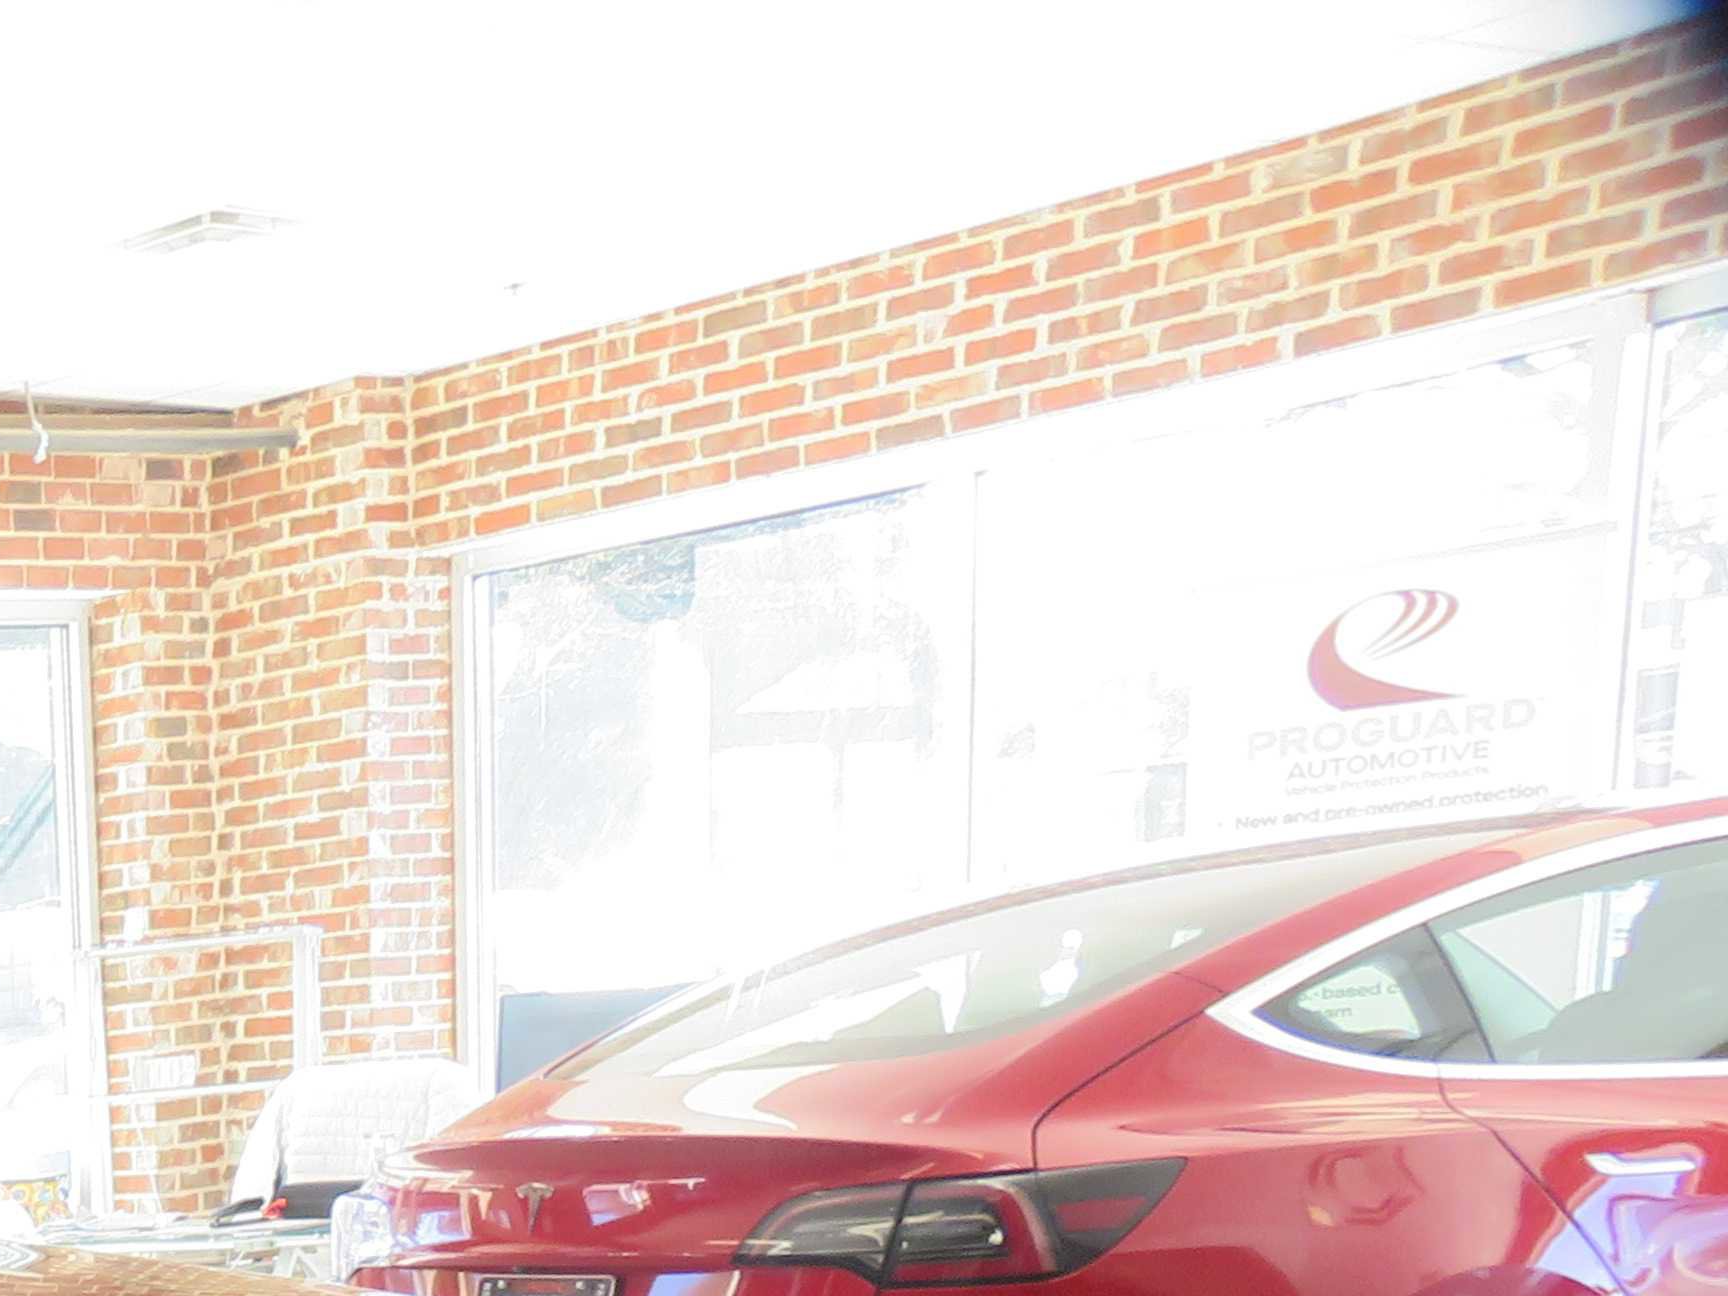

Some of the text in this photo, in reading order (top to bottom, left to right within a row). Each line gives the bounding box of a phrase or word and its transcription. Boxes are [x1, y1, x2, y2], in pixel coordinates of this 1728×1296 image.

[1247, 698, 1537, 761] PROGUARD
[1286, 740, 1490, 781] AUTOMOTIVE
[1341, 773, 1417, 791] Protection
[1421, 766, 1489, 781] Products
[1235, 784, 1549, 830] New and pre-owned protection
